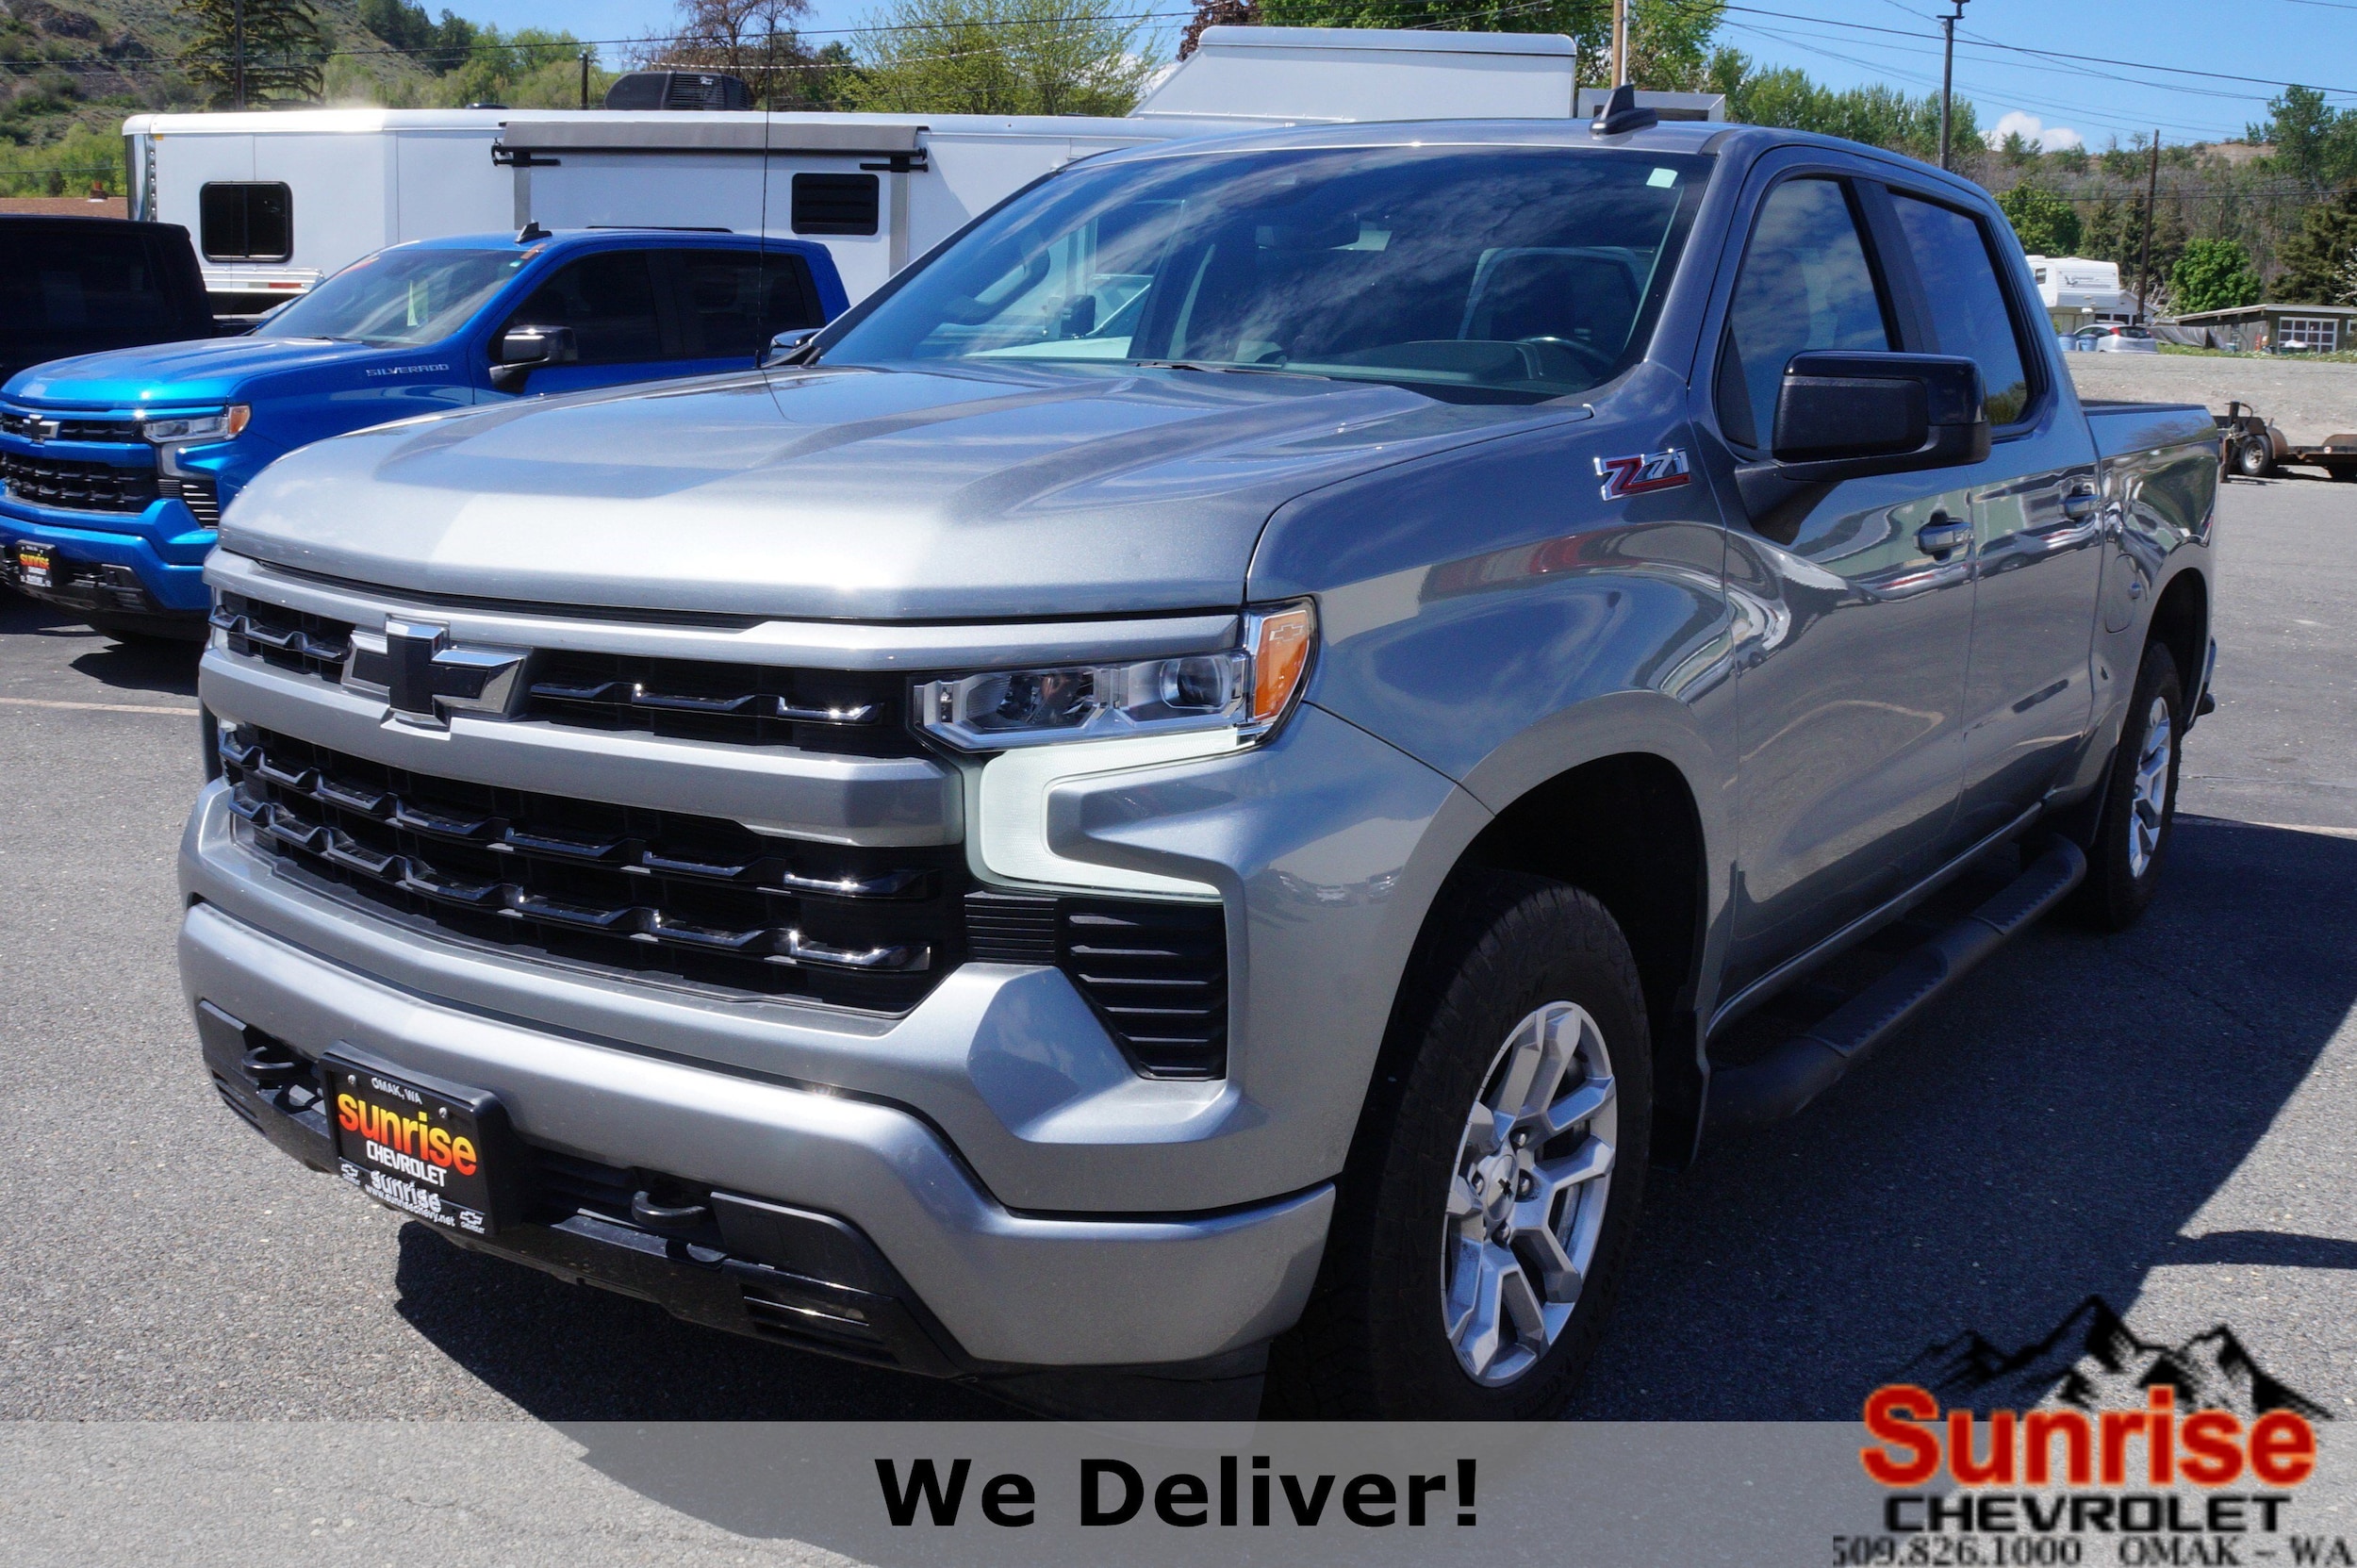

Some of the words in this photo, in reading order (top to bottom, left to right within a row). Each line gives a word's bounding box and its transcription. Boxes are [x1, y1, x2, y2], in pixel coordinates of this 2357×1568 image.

[365, 363, 451, 377] SILVERADO
[1593, 447, 1691, 502] Z71
[404, 1088, 423, 1105] WA
[338, 1093, 477, 1176] sunrise
[366, 1139, 447, 1188] CHEVROLET
[371, 1169, 442, 1213] sunrise
